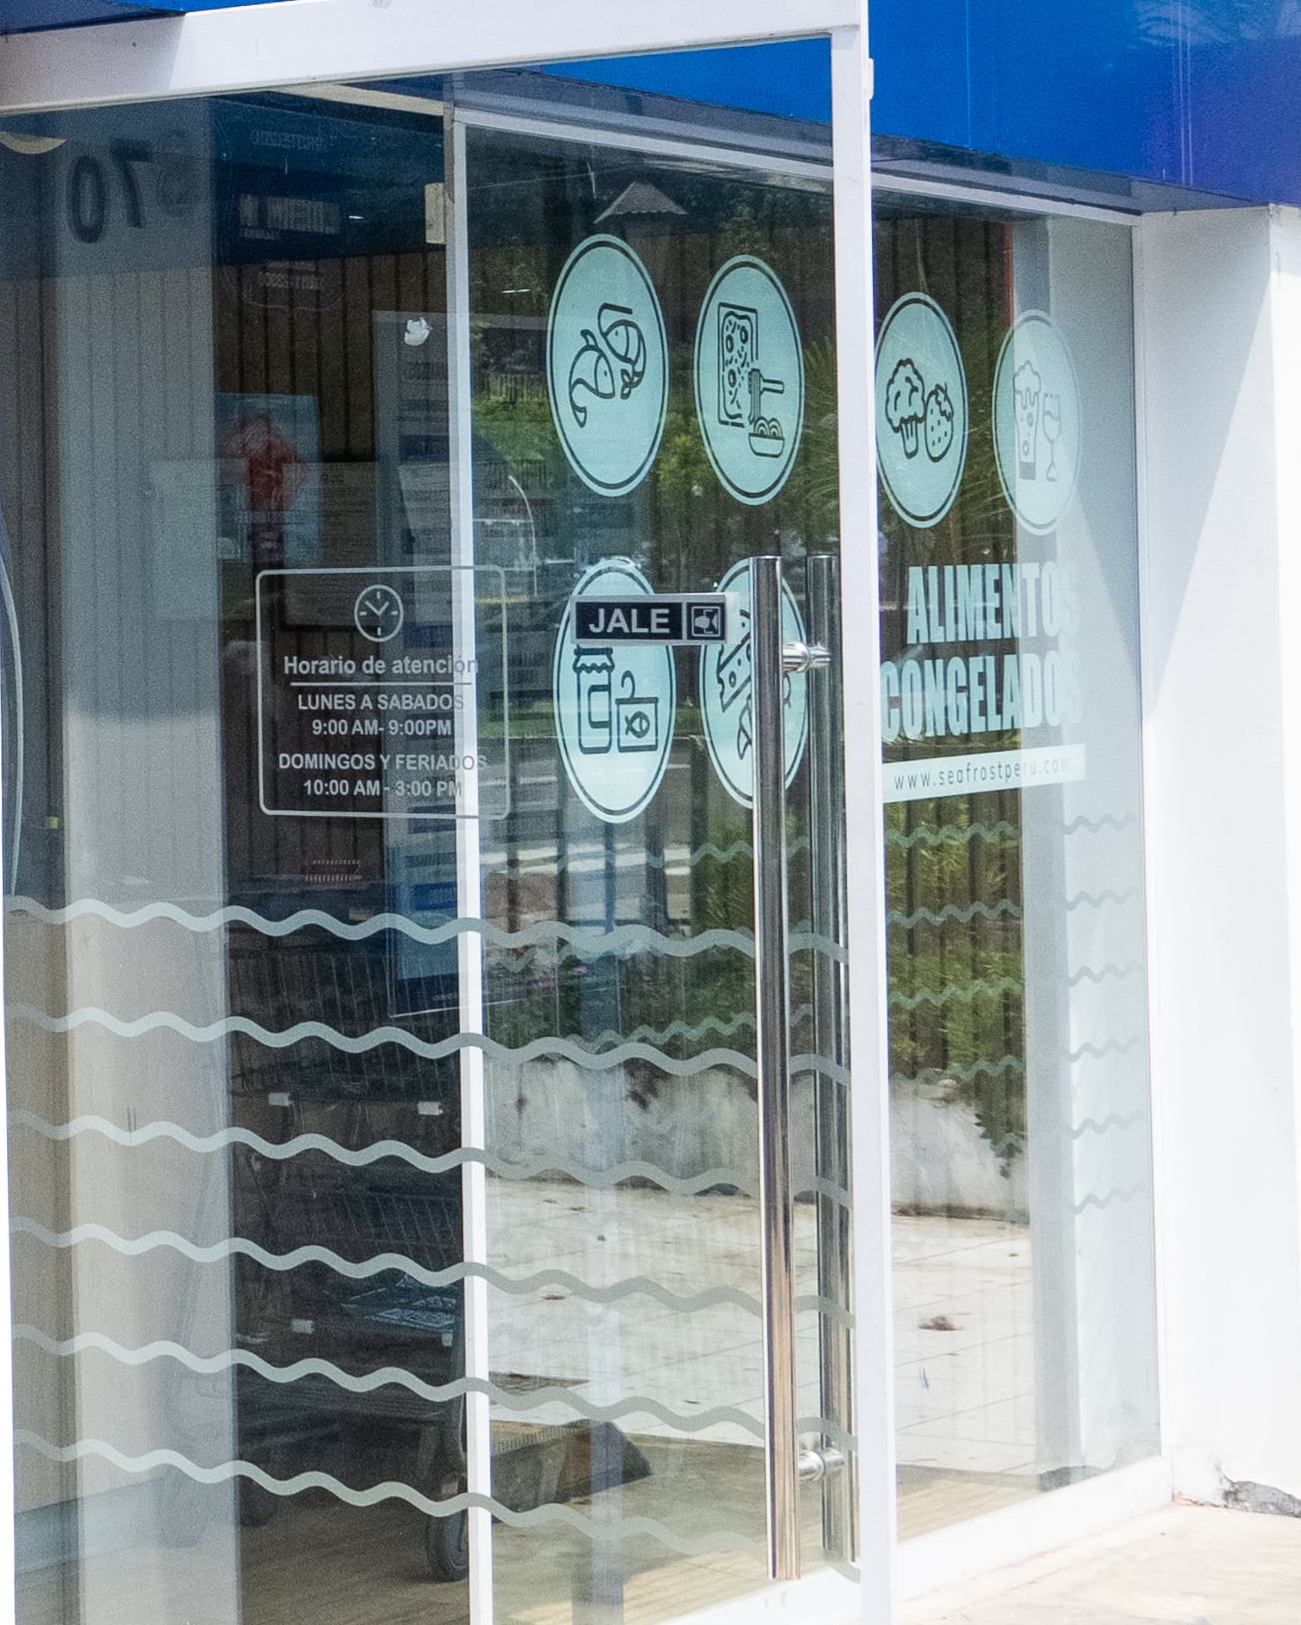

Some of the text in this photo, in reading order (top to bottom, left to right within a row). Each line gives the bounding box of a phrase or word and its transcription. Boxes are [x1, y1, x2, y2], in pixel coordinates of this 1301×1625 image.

[907, 561, 1081, 644] ALIMENTOS
[588, 608, 670, 634] JALE
[284, 655, 478, 675] Horario de atención
[298, 694, 464, 710] LUNES A SABADOS
[880, 651, 1081, 743] CONGELADOS
[312, 719, 348, 735] 9:00
[388, 719, 451, 736] 9:00PM
[279, 753, 487, 770] DOMINGOS Y FERIADOS
[895, 758, 1071, 790] www.seafrostperu.com
[304, 779, 348, 796] 10:00
[354, 780, 380, 796] AM
[396, 780, 432, 796] 3:00
[437, 781, 462, 797] PM
